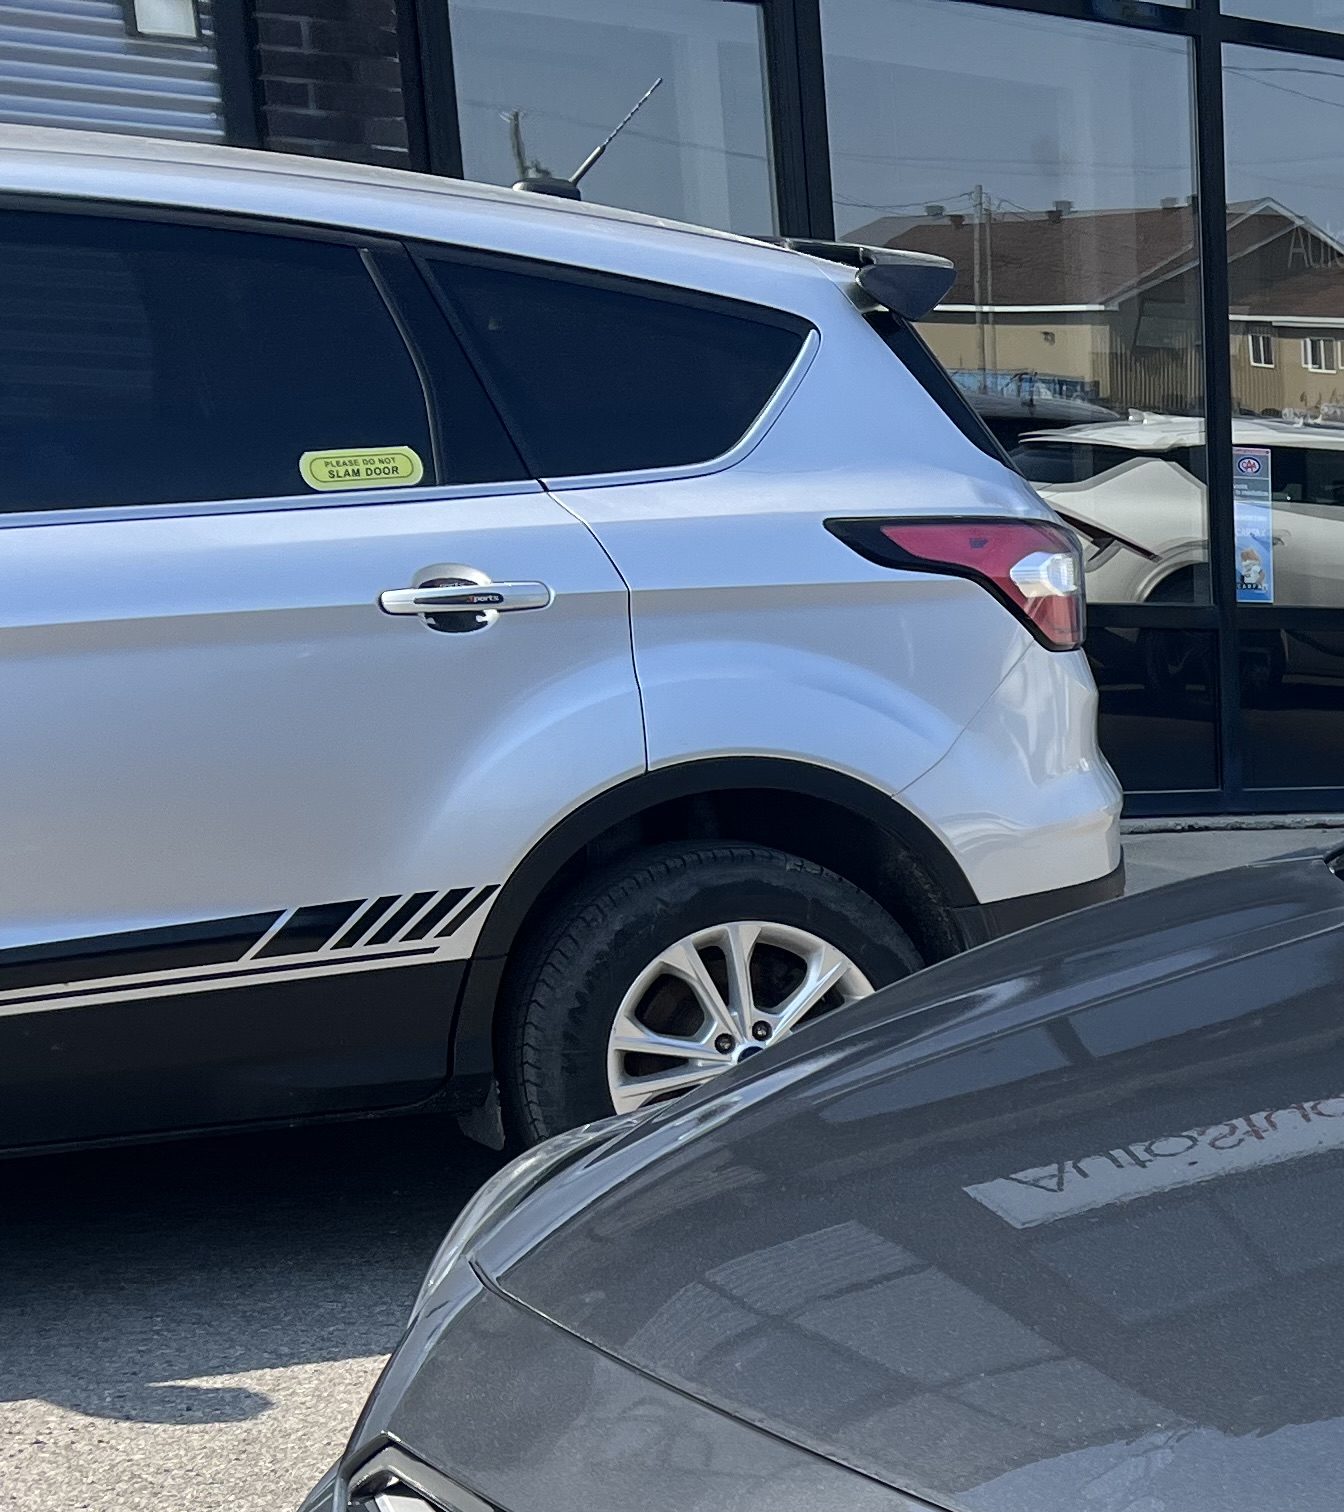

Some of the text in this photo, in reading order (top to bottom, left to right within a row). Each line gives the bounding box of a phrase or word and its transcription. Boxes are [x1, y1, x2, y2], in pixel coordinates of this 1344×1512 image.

[324, 456, 397, 468] PLEASE DO NOT
[328, 465, 400, 479] SLAM DOOR
